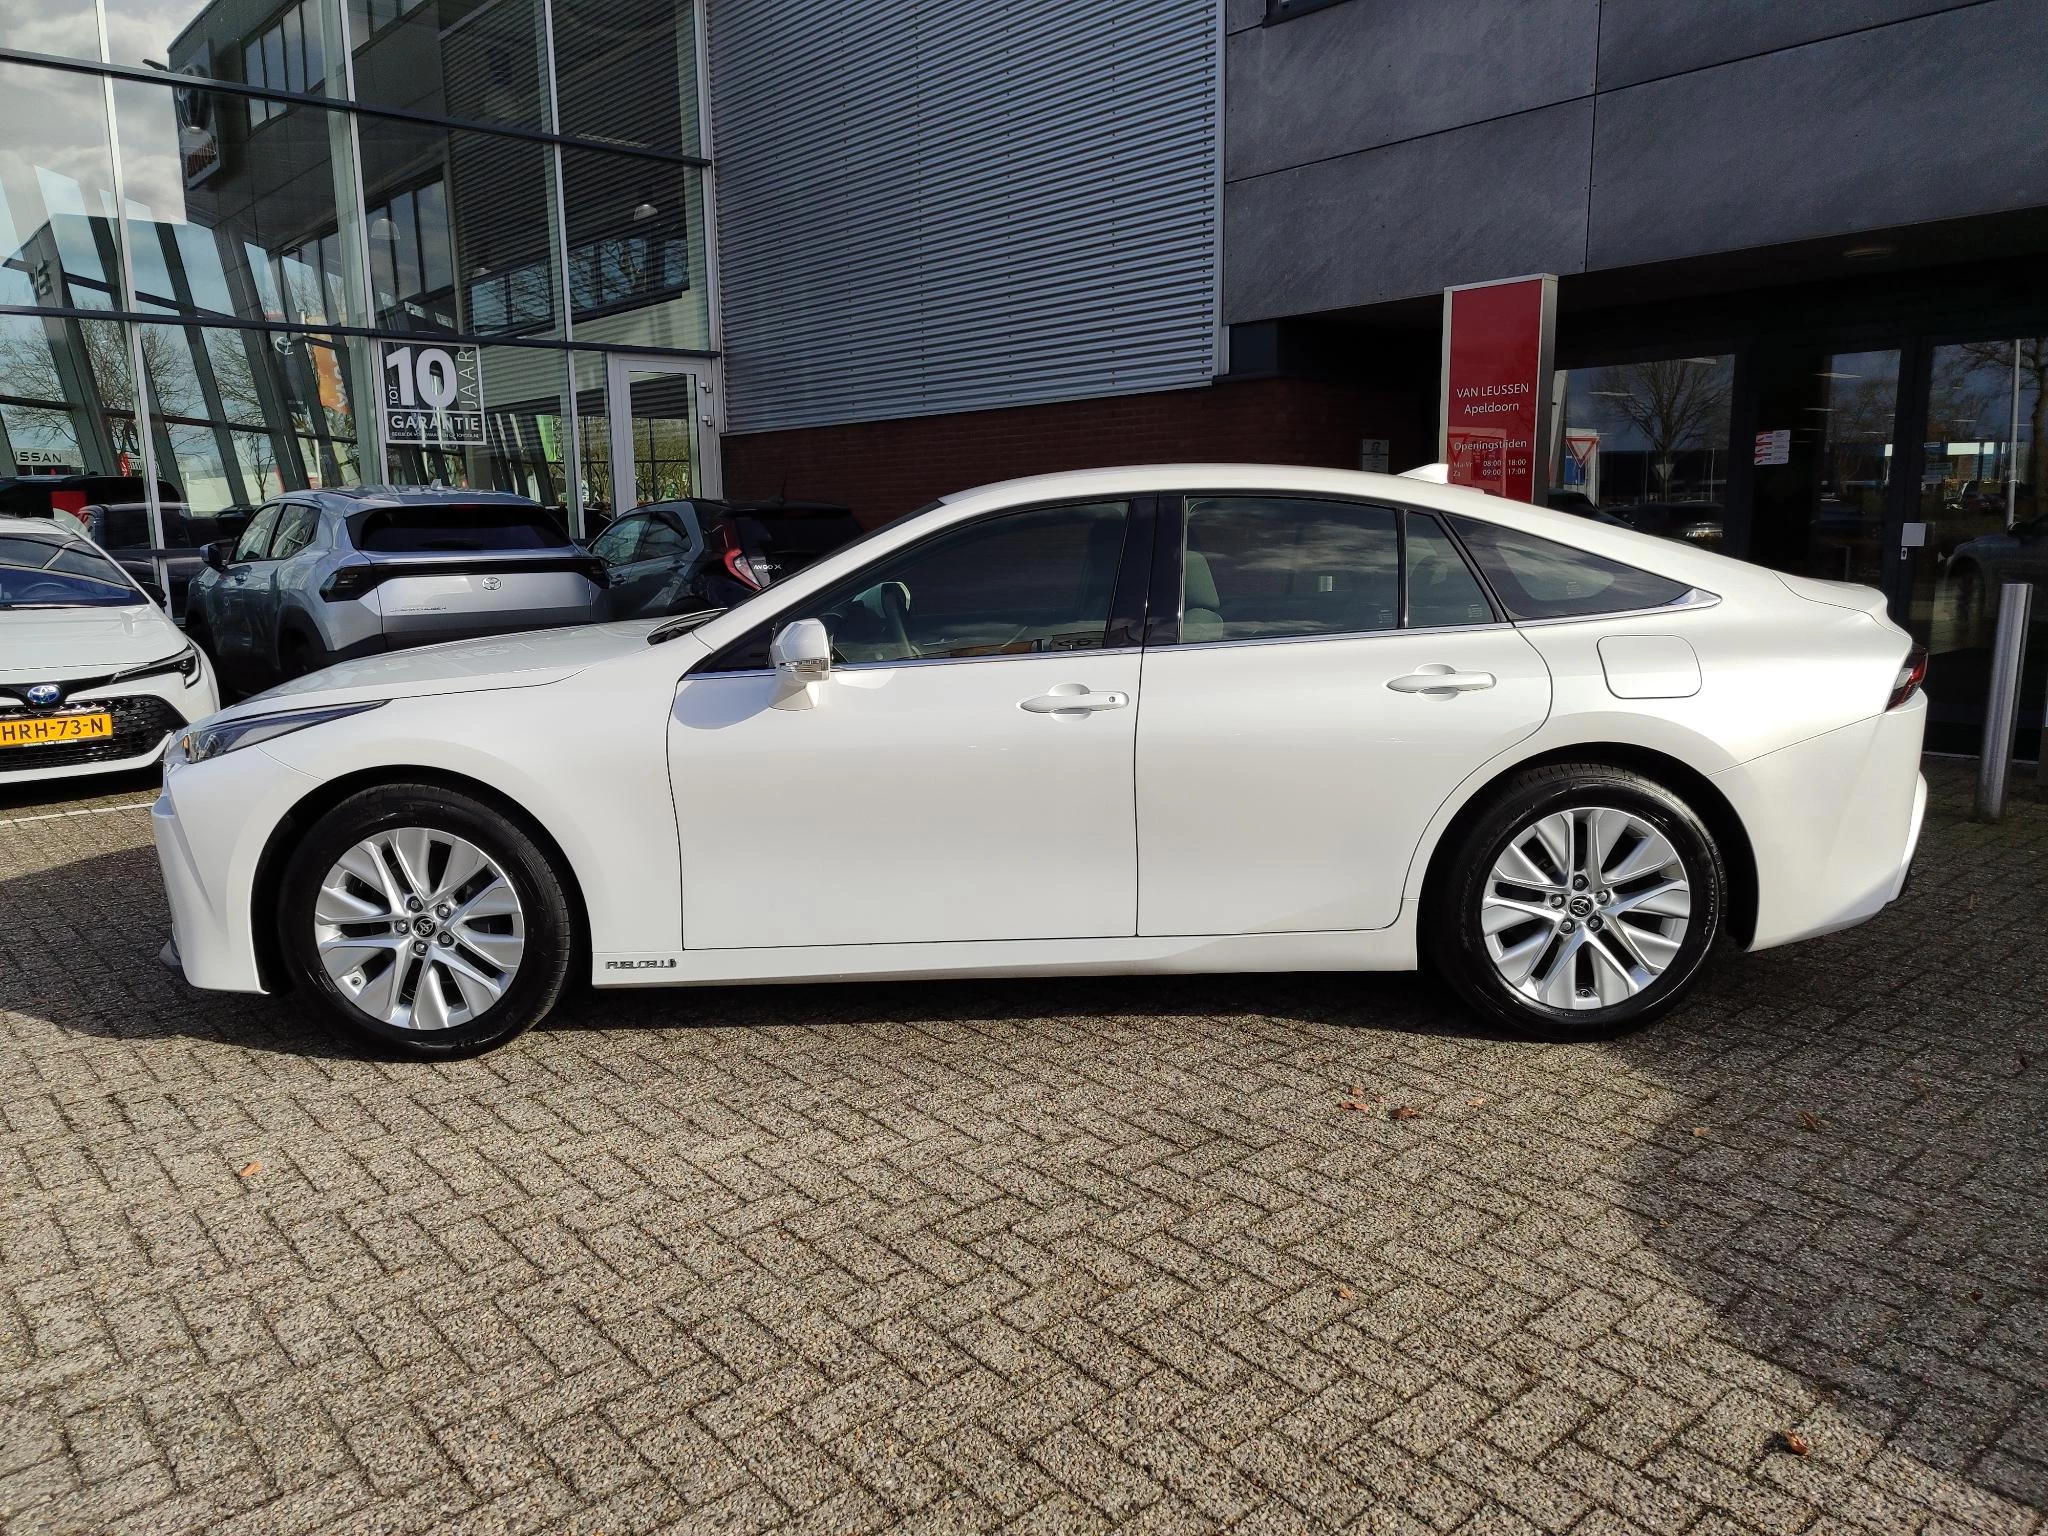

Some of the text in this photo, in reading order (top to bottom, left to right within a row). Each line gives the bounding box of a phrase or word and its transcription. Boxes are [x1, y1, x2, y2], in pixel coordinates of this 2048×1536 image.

[386, 346, 458, 409] 10
[457, 350, 478, 409] JAAR
[388, 384, 399, 406] TOT
[1456, 383, 1529, 398] VAN LEUSSEN
[1464, 402, 1520, 416] Apeldoorn
[391, 415, 480, 431] GARANTIE
[1454, 439, 1527, 453] Openingstijden
[1507, 458, 1527, 466] 18:00
[1507, 467, 1526, 476] 17:00
[2, 717, 104, 741] HRH-73-N
